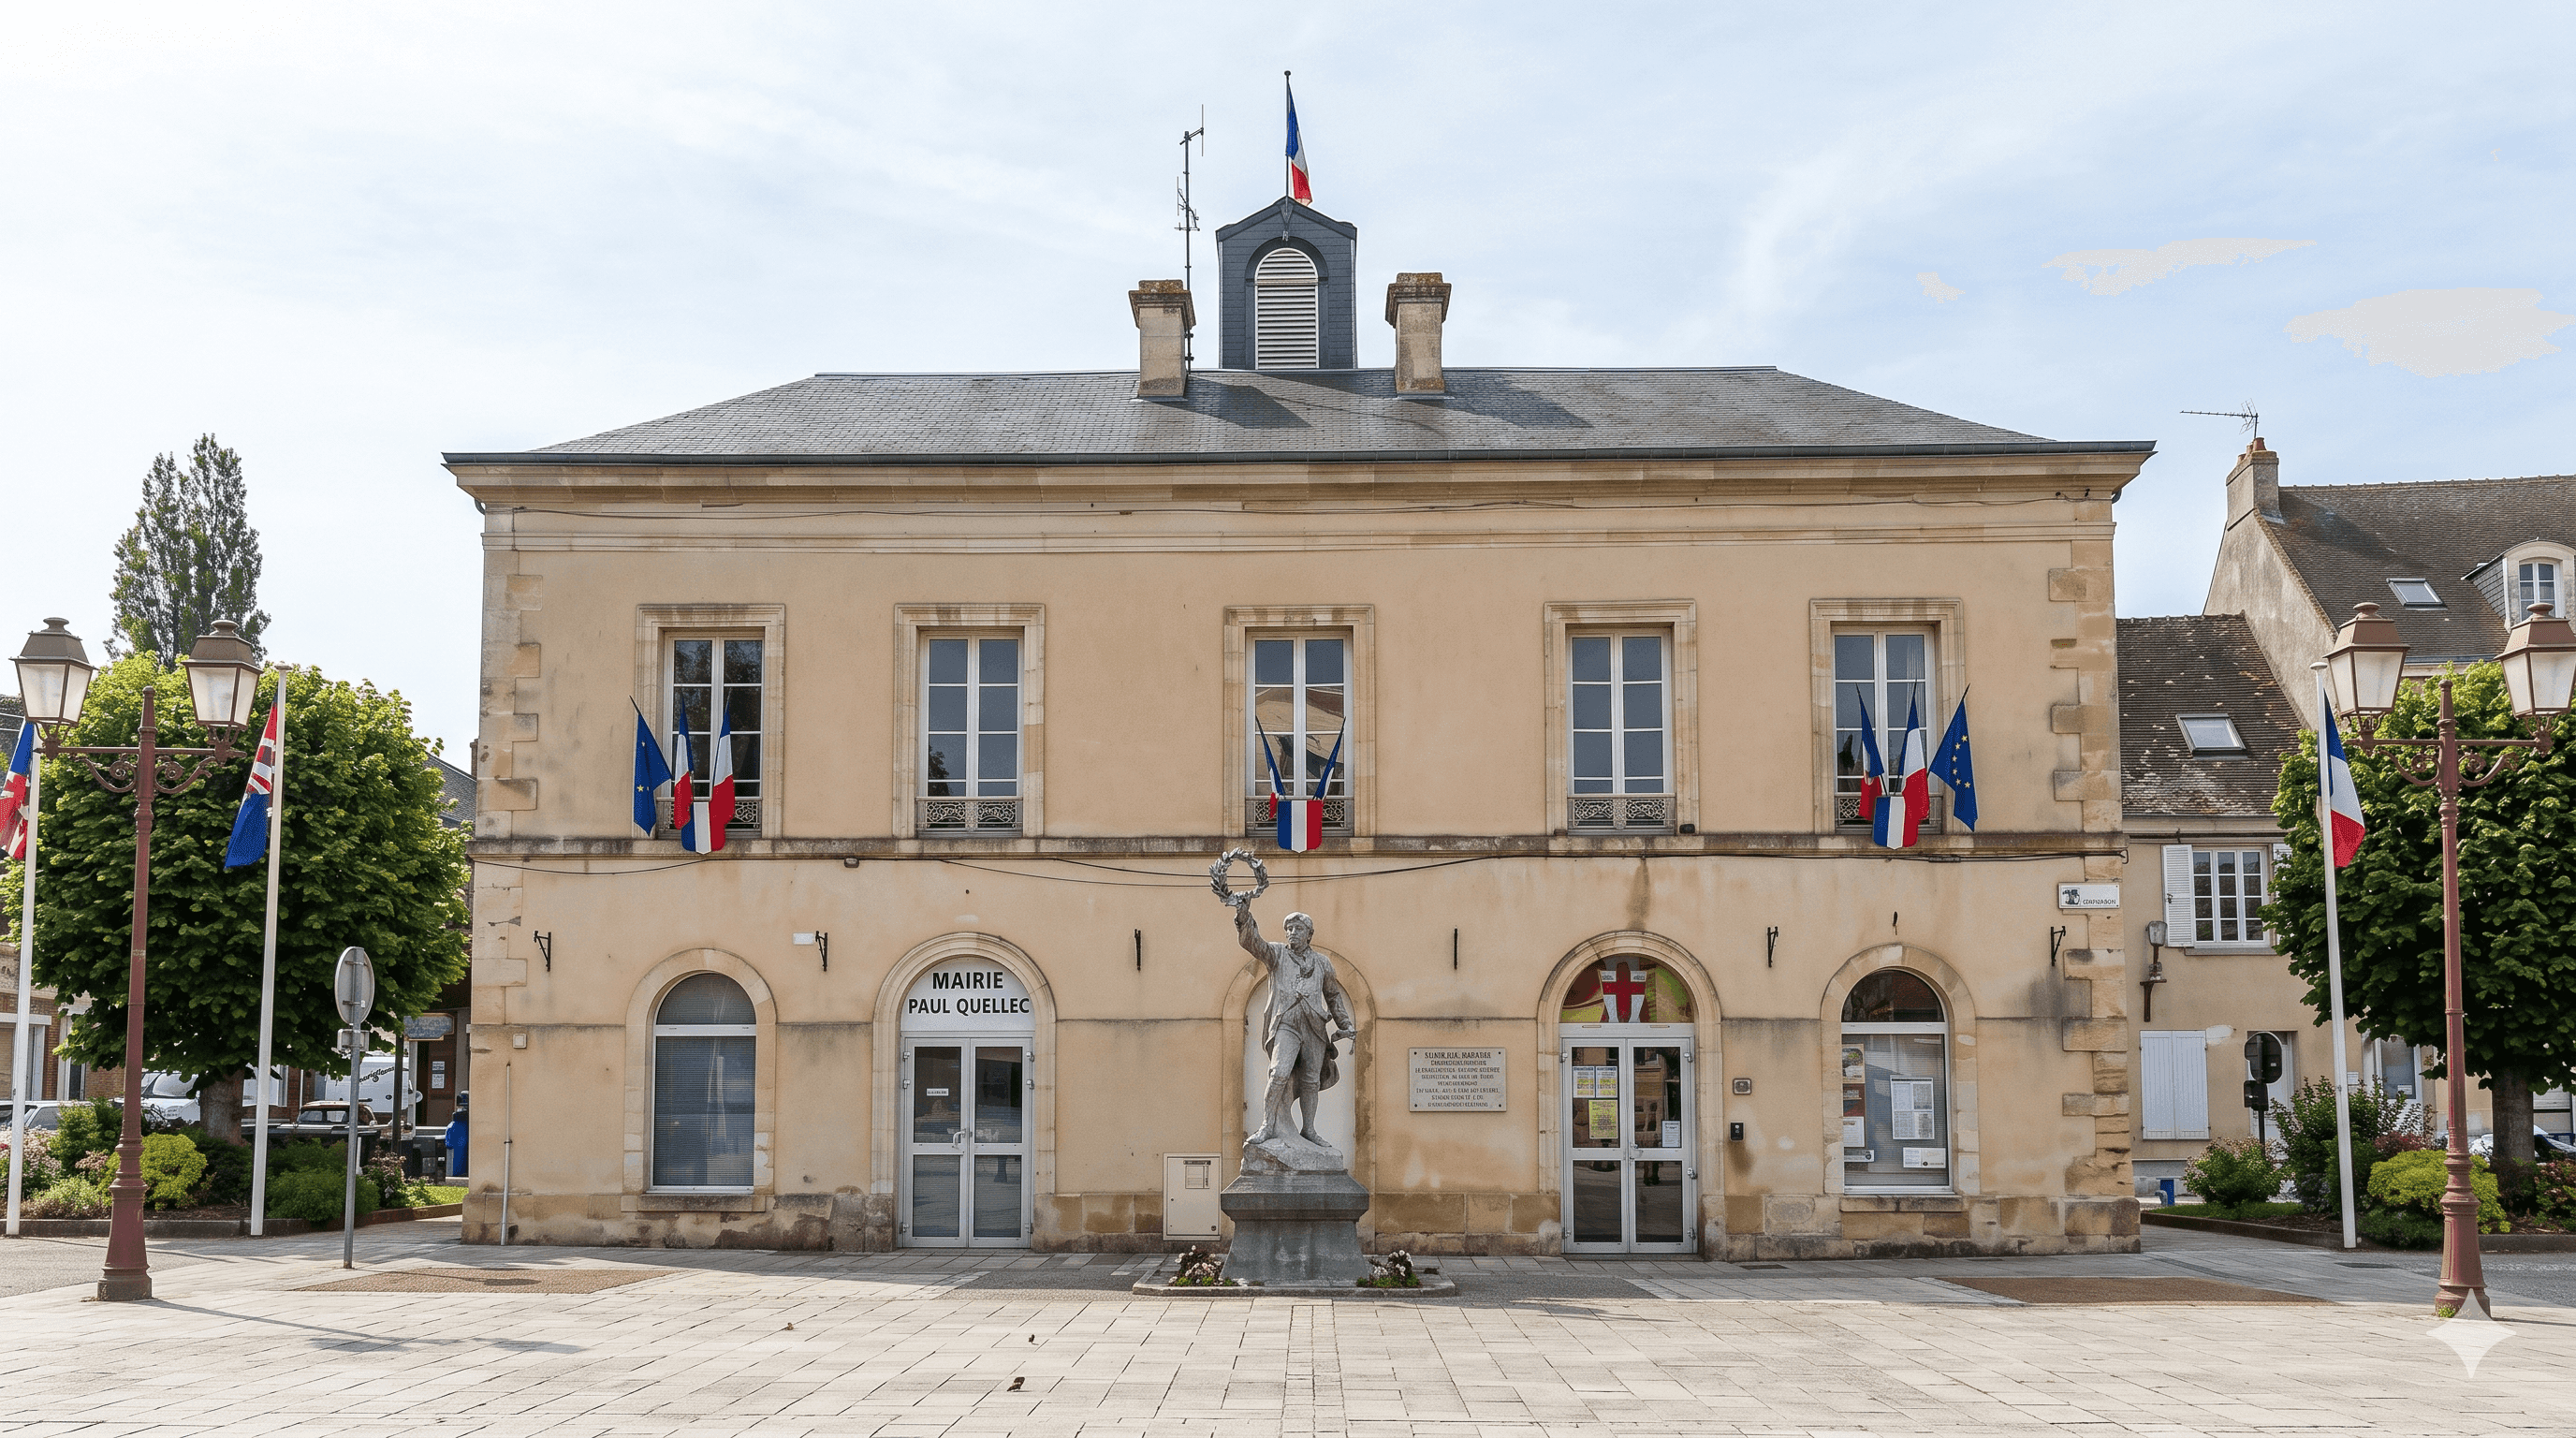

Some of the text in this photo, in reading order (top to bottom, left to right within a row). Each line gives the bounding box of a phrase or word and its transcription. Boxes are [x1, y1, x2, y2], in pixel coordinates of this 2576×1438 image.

[932, 971, 1003, 990] MAIRIE
[908, 997, 1030, 1017] PAUL QUELLEC
